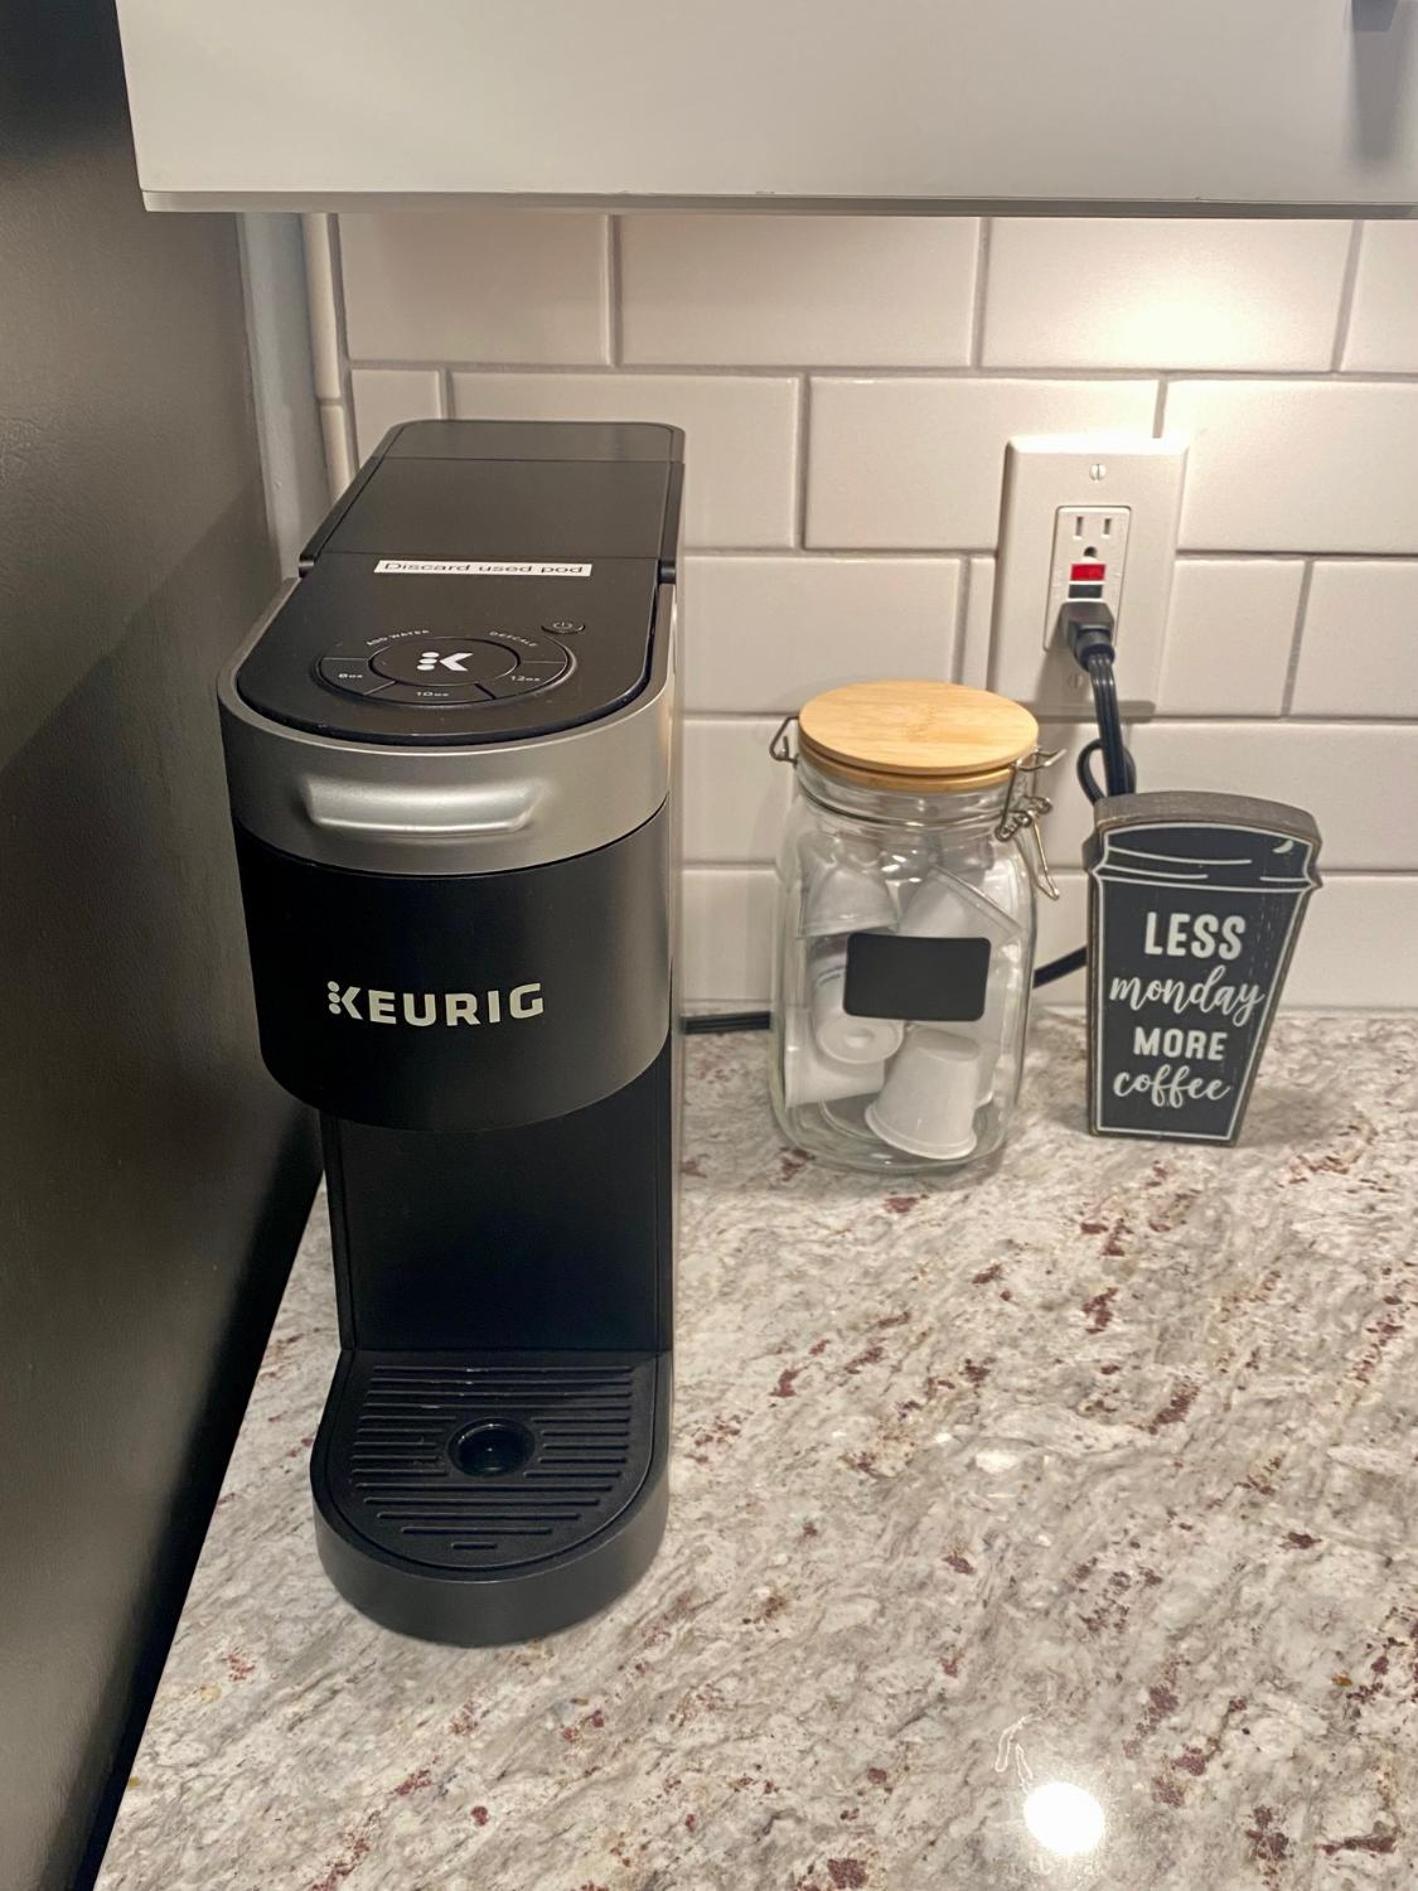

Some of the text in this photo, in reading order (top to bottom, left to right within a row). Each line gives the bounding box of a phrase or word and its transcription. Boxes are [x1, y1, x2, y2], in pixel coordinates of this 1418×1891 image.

[385, 562, 584, 574] Discard used pod
[1144, 911, 1246, 960] LESS
[327, 980, 544, 1027] KEURIG
[1109, 964, 1265, 1027] monday
[1133, 1026, 1228, 1061] MORE
[1113, 1064, 1231, 1109] coffee
